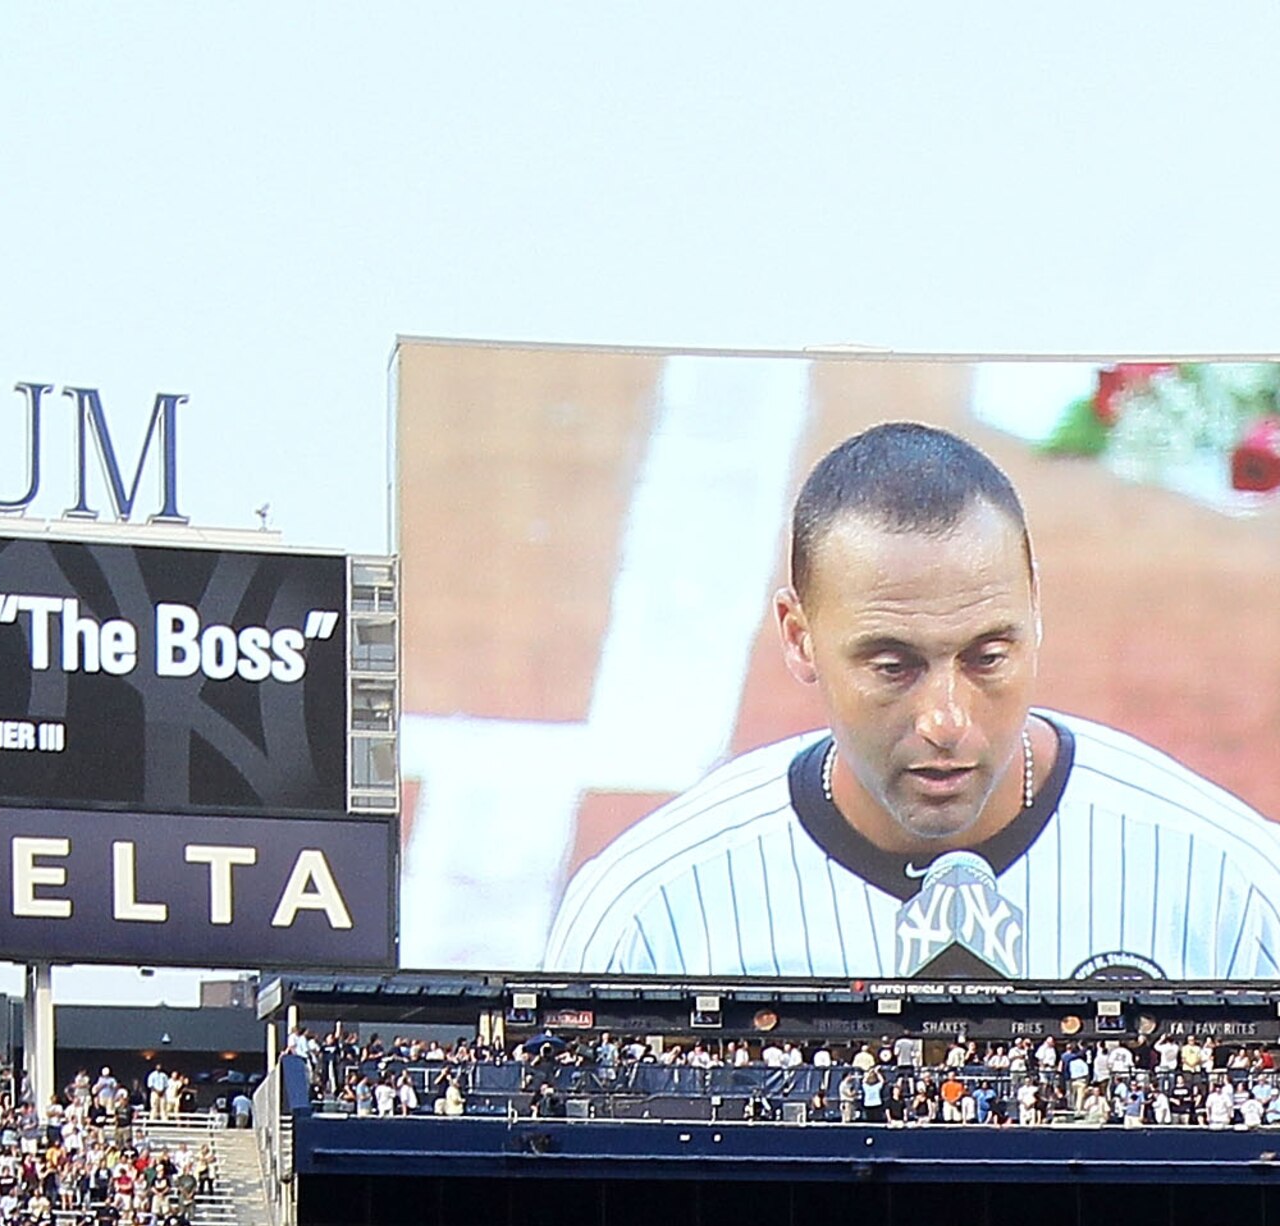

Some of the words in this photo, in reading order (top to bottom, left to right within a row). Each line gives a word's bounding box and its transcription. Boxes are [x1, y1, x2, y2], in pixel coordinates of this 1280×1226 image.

[39, 723, 64, 751] III
[923, 1021, 969, 1035] SHAKES
[1011, 1022, 1042, 1035] FRIES
